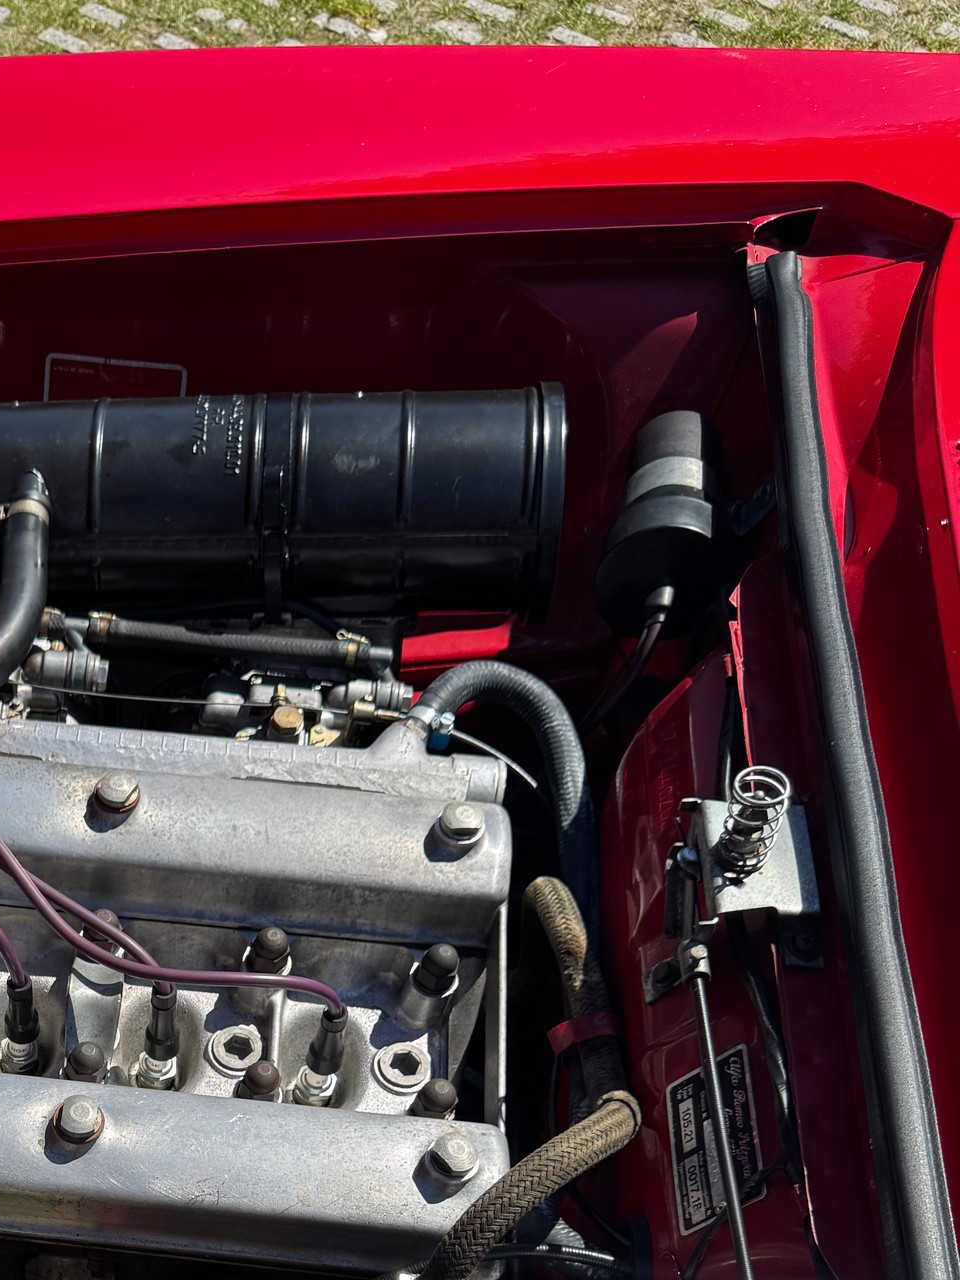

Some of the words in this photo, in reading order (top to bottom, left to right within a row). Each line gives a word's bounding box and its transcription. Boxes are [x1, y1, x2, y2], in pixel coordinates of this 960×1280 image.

[724, 1056, 741, 1086] Alfa
[733, 1090, 746, 1128] Romeo
[681, 1107, 694, 1144] 105.21
